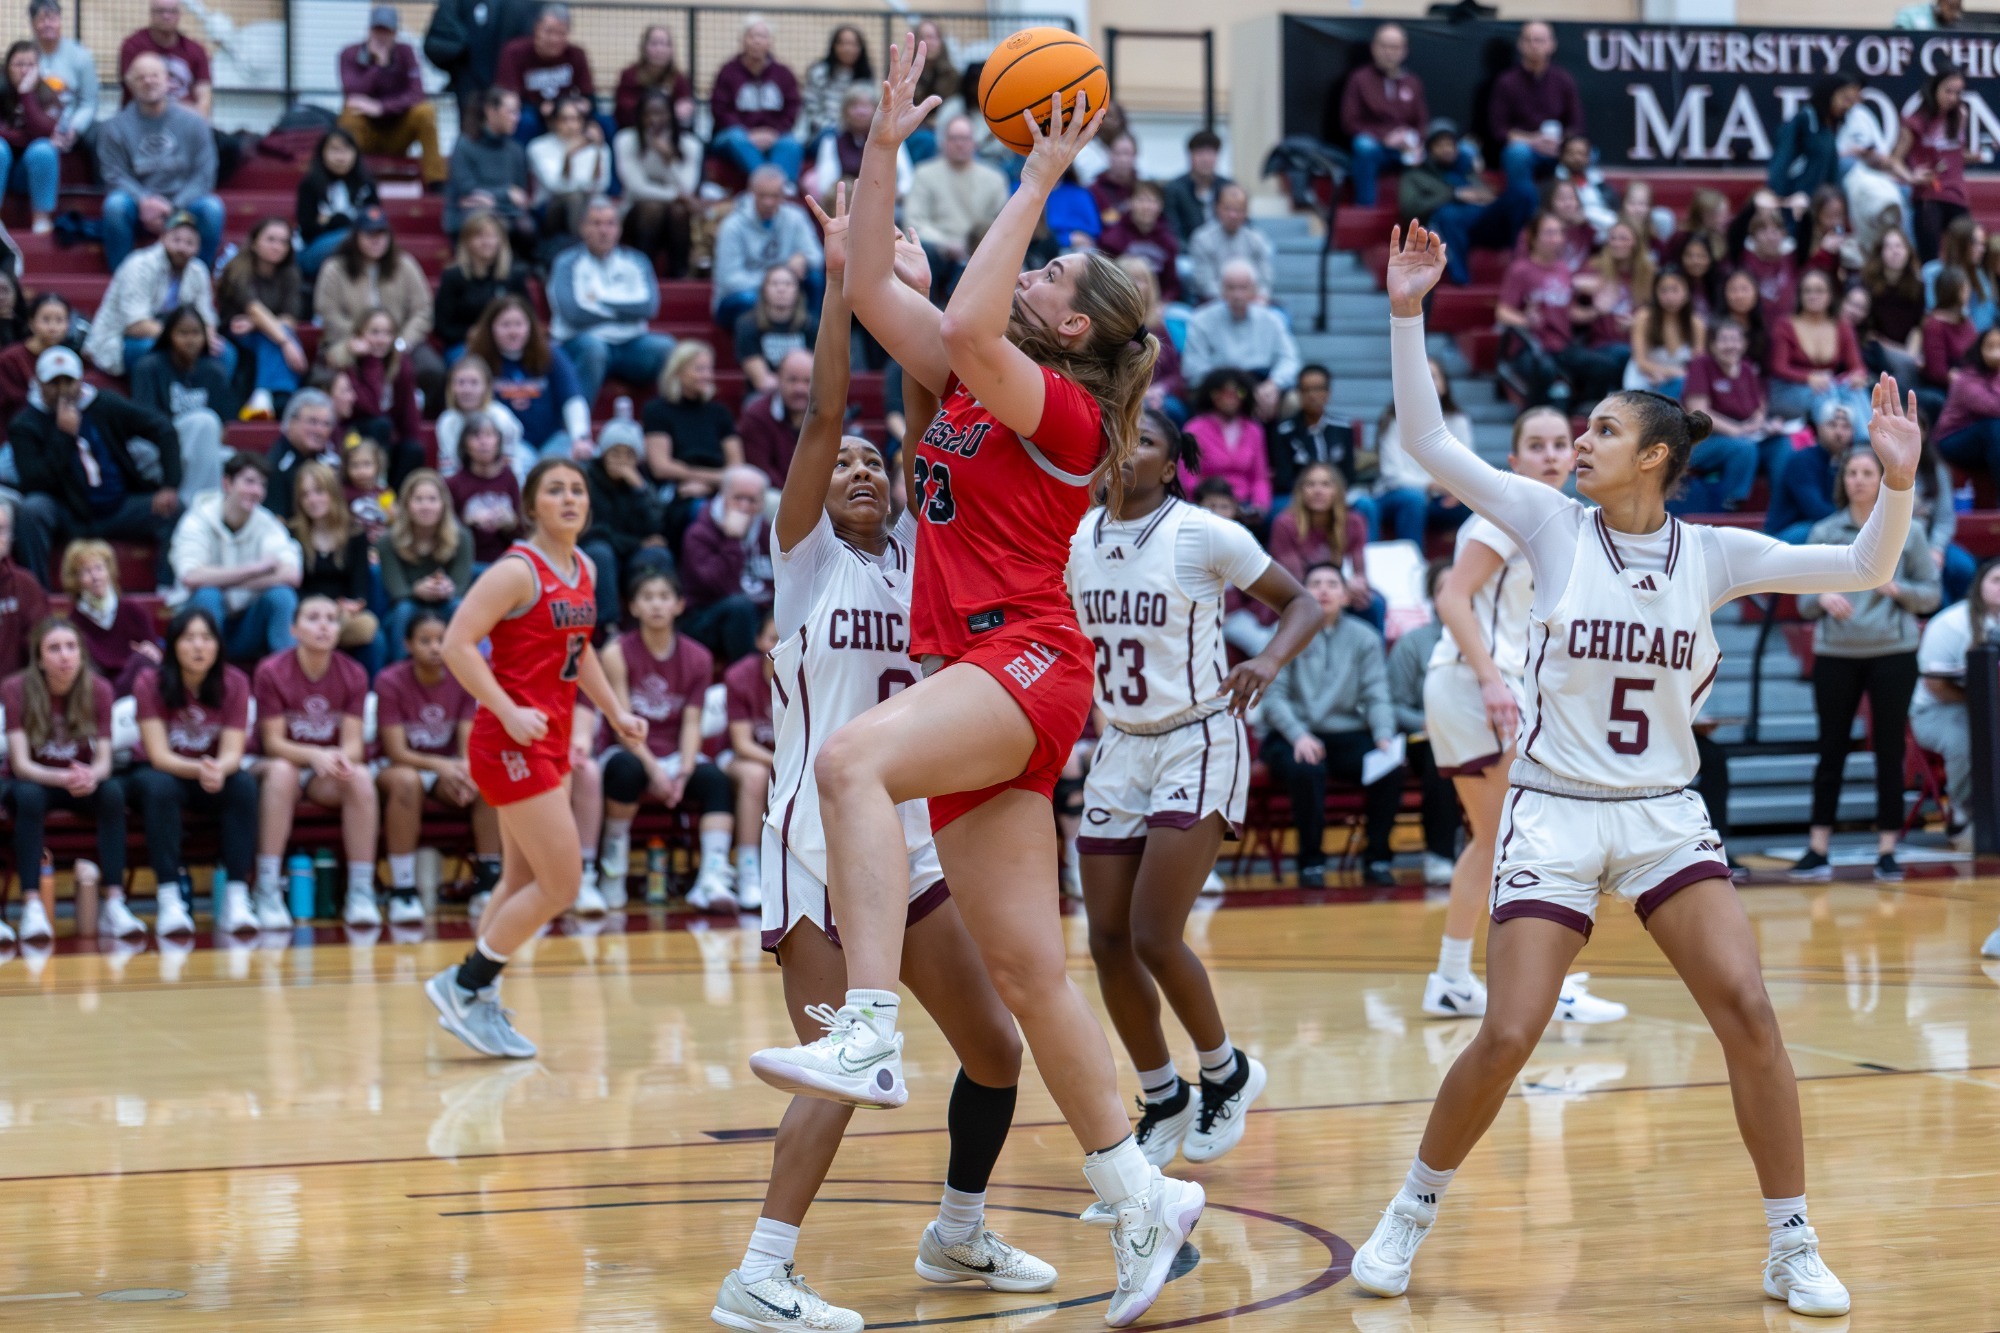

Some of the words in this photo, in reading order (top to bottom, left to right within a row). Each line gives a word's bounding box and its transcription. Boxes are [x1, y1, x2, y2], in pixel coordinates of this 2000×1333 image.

[1586, 30, 1849, 74] UNIVERSITY
[1856, 35, 1914, 76] OF
[920, 409, 992, 459] ashU
[829, 608, 911, 653] CHIC
[1081, 589, 1167, 627] HICAGO
[1092, 636, 1148, 706] 23
[1606, 677, 1656, 756] 5
